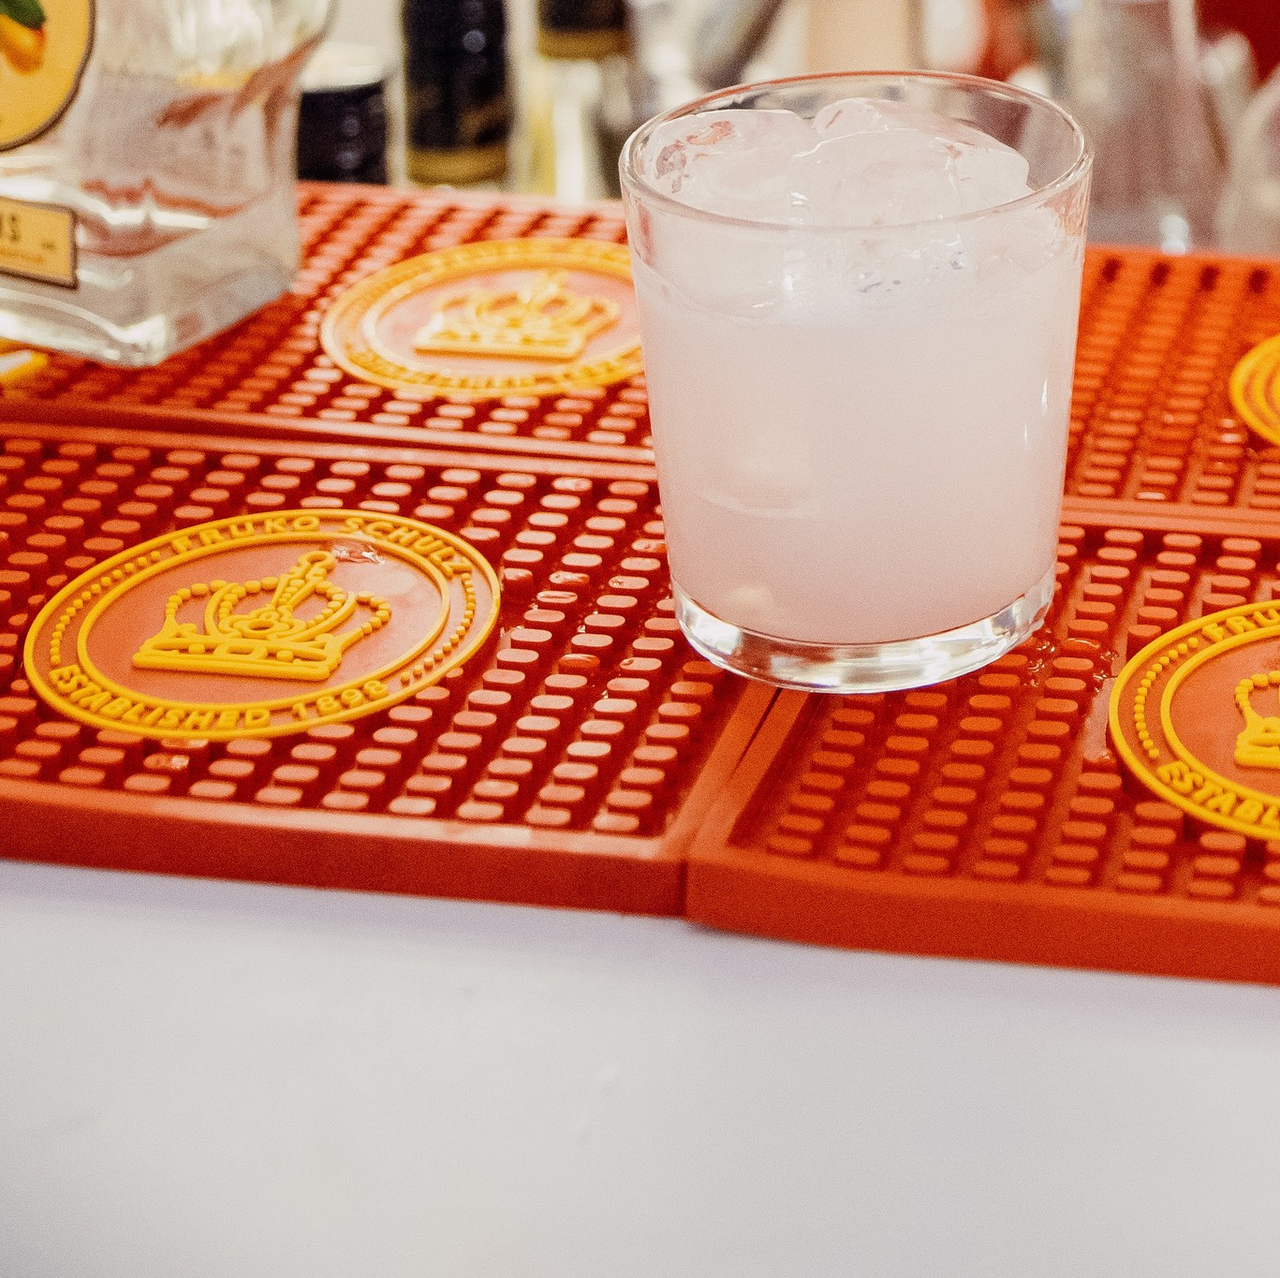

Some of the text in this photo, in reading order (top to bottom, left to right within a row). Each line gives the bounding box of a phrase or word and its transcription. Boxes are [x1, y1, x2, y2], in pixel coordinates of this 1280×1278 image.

[171, 515, 474, 578] FRUKO SCHULZ
[49, 664, 389, 732] ESTABLISHED 1898
